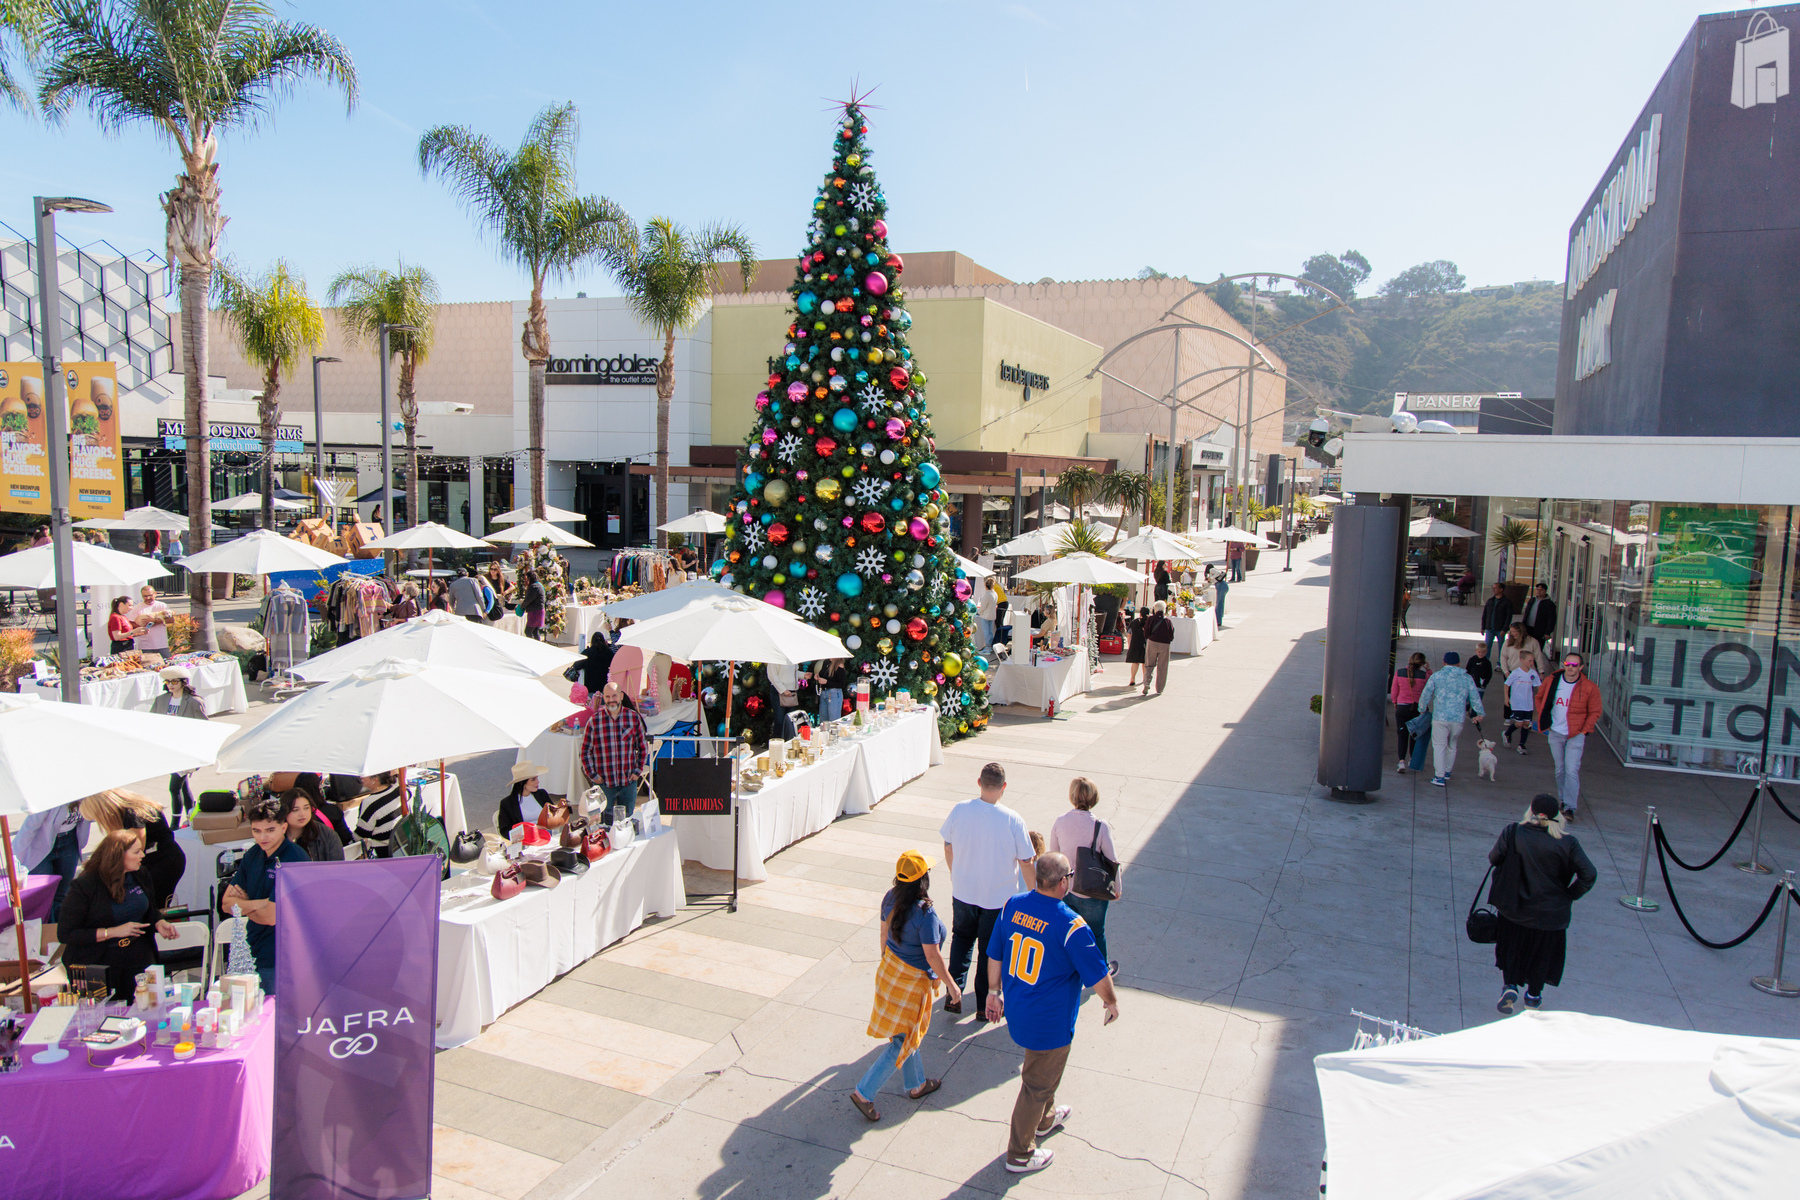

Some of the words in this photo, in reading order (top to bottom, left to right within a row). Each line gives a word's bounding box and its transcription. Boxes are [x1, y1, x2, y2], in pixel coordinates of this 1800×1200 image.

[1575, 288, 1618, 380] RACK
[622, 375, 640, 383] outlet
[164, 421, 257, 438] MEOCINO
[2, 431, 16, 443] BIG
[73, 434, 86, 446] BIG
[2, 442, 45, 457] FLAVORS,
[73, 445, 116, 460] FLAVORS,
[3, 453, 27, 464] HUGE
[73, 457, 97, 468] HUGE
[3, 463, 45, 476] SCREENS.
[72, 467, 116, 480] SCREENS.
[1680, 556, 1704, 564] People
[1681, 567, 1707, 575] Jacobs
[1655, 603, 1680, 611] Great
[1654, 611, 1680, 619] Great
[665, 798, 681, 811] THE
[682, 798, 724, 811] BANDIDAS
[1011, 911, 1049, 934] HERBERT
[1008, 931, 1045, 986] 10
[297, 1006, 415, 1035] JAFRA
